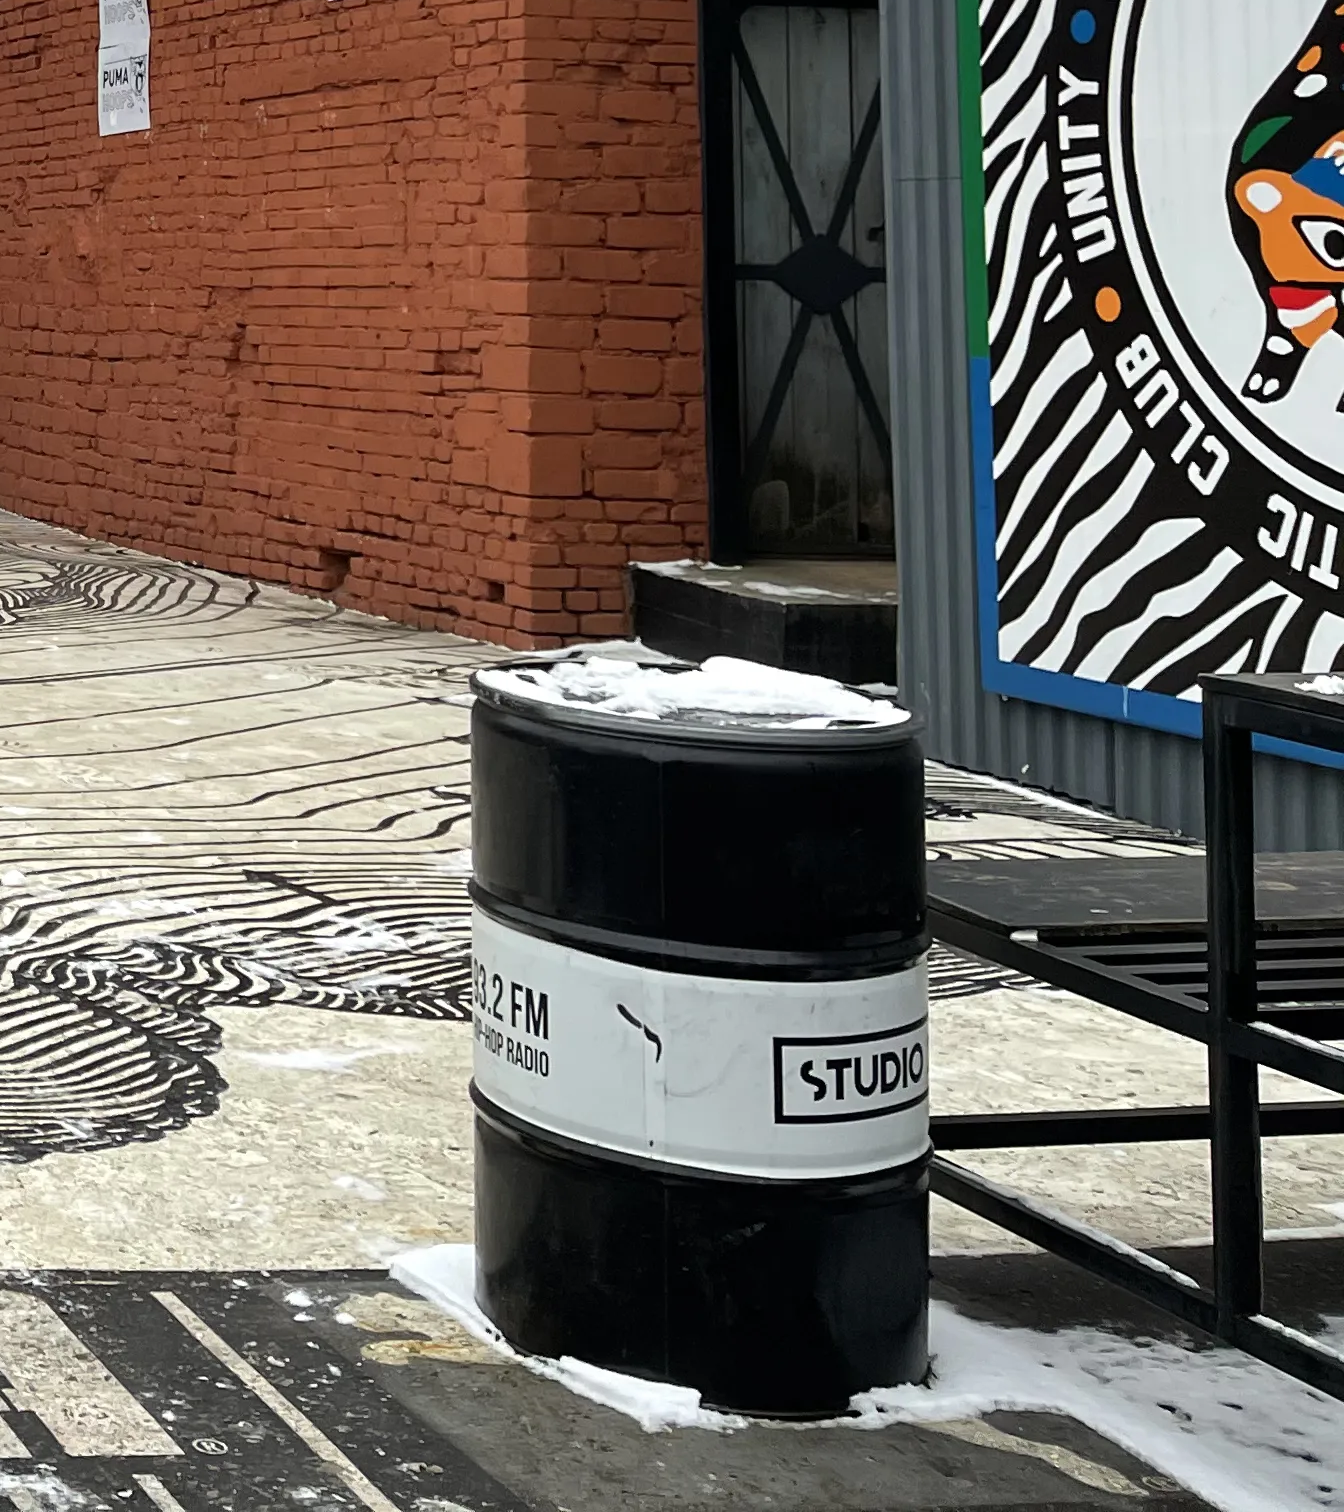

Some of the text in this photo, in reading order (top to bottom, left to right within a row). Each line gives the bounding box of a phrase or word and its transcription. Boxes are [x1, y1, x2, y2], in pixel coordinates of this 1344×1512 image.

[104, 1, 136, 26] HOOPS
[102, 89, 134, 113] HOOPS
[103, 66, 128, 88] PUMA
[1058, 66, 1116, 263] UNITY
[1114, 333, 1230, 496] CLUB
[511, 981, 549, 1040] FM
[506, 1037, 549, 1077] RADIO
[800, 1043, 924, 1102] STUDIO
